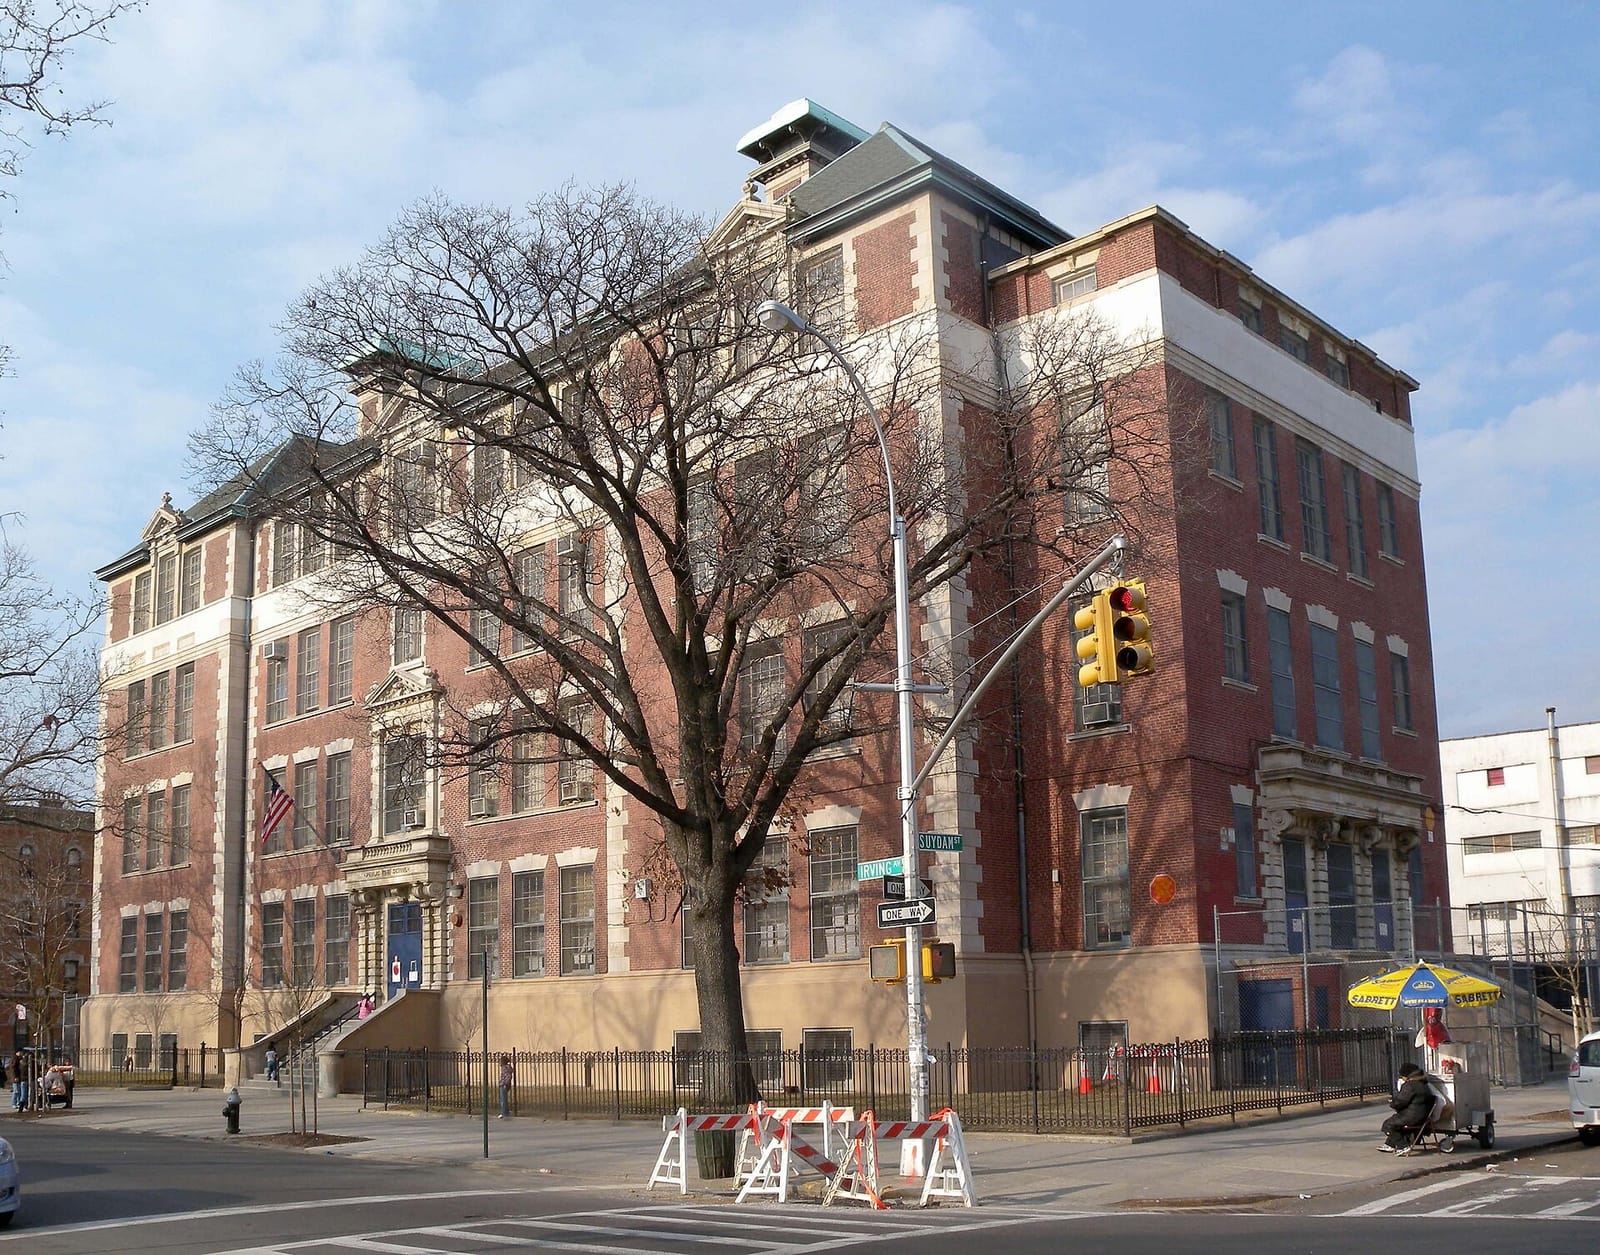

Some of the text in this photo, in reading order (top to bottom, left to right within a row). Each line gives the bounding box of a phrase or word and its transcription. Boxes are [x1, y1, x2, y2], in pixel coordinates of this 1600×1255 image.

[920, 834, 961, 849] SUYDAM ST
[860, 861, 892, 879] IRVING
[886, 906, 927, 920] ONE WAY
[1351, 994, 1397, 1005] SABRETT
[1455, 990, 1500, 1004] SABRETT
